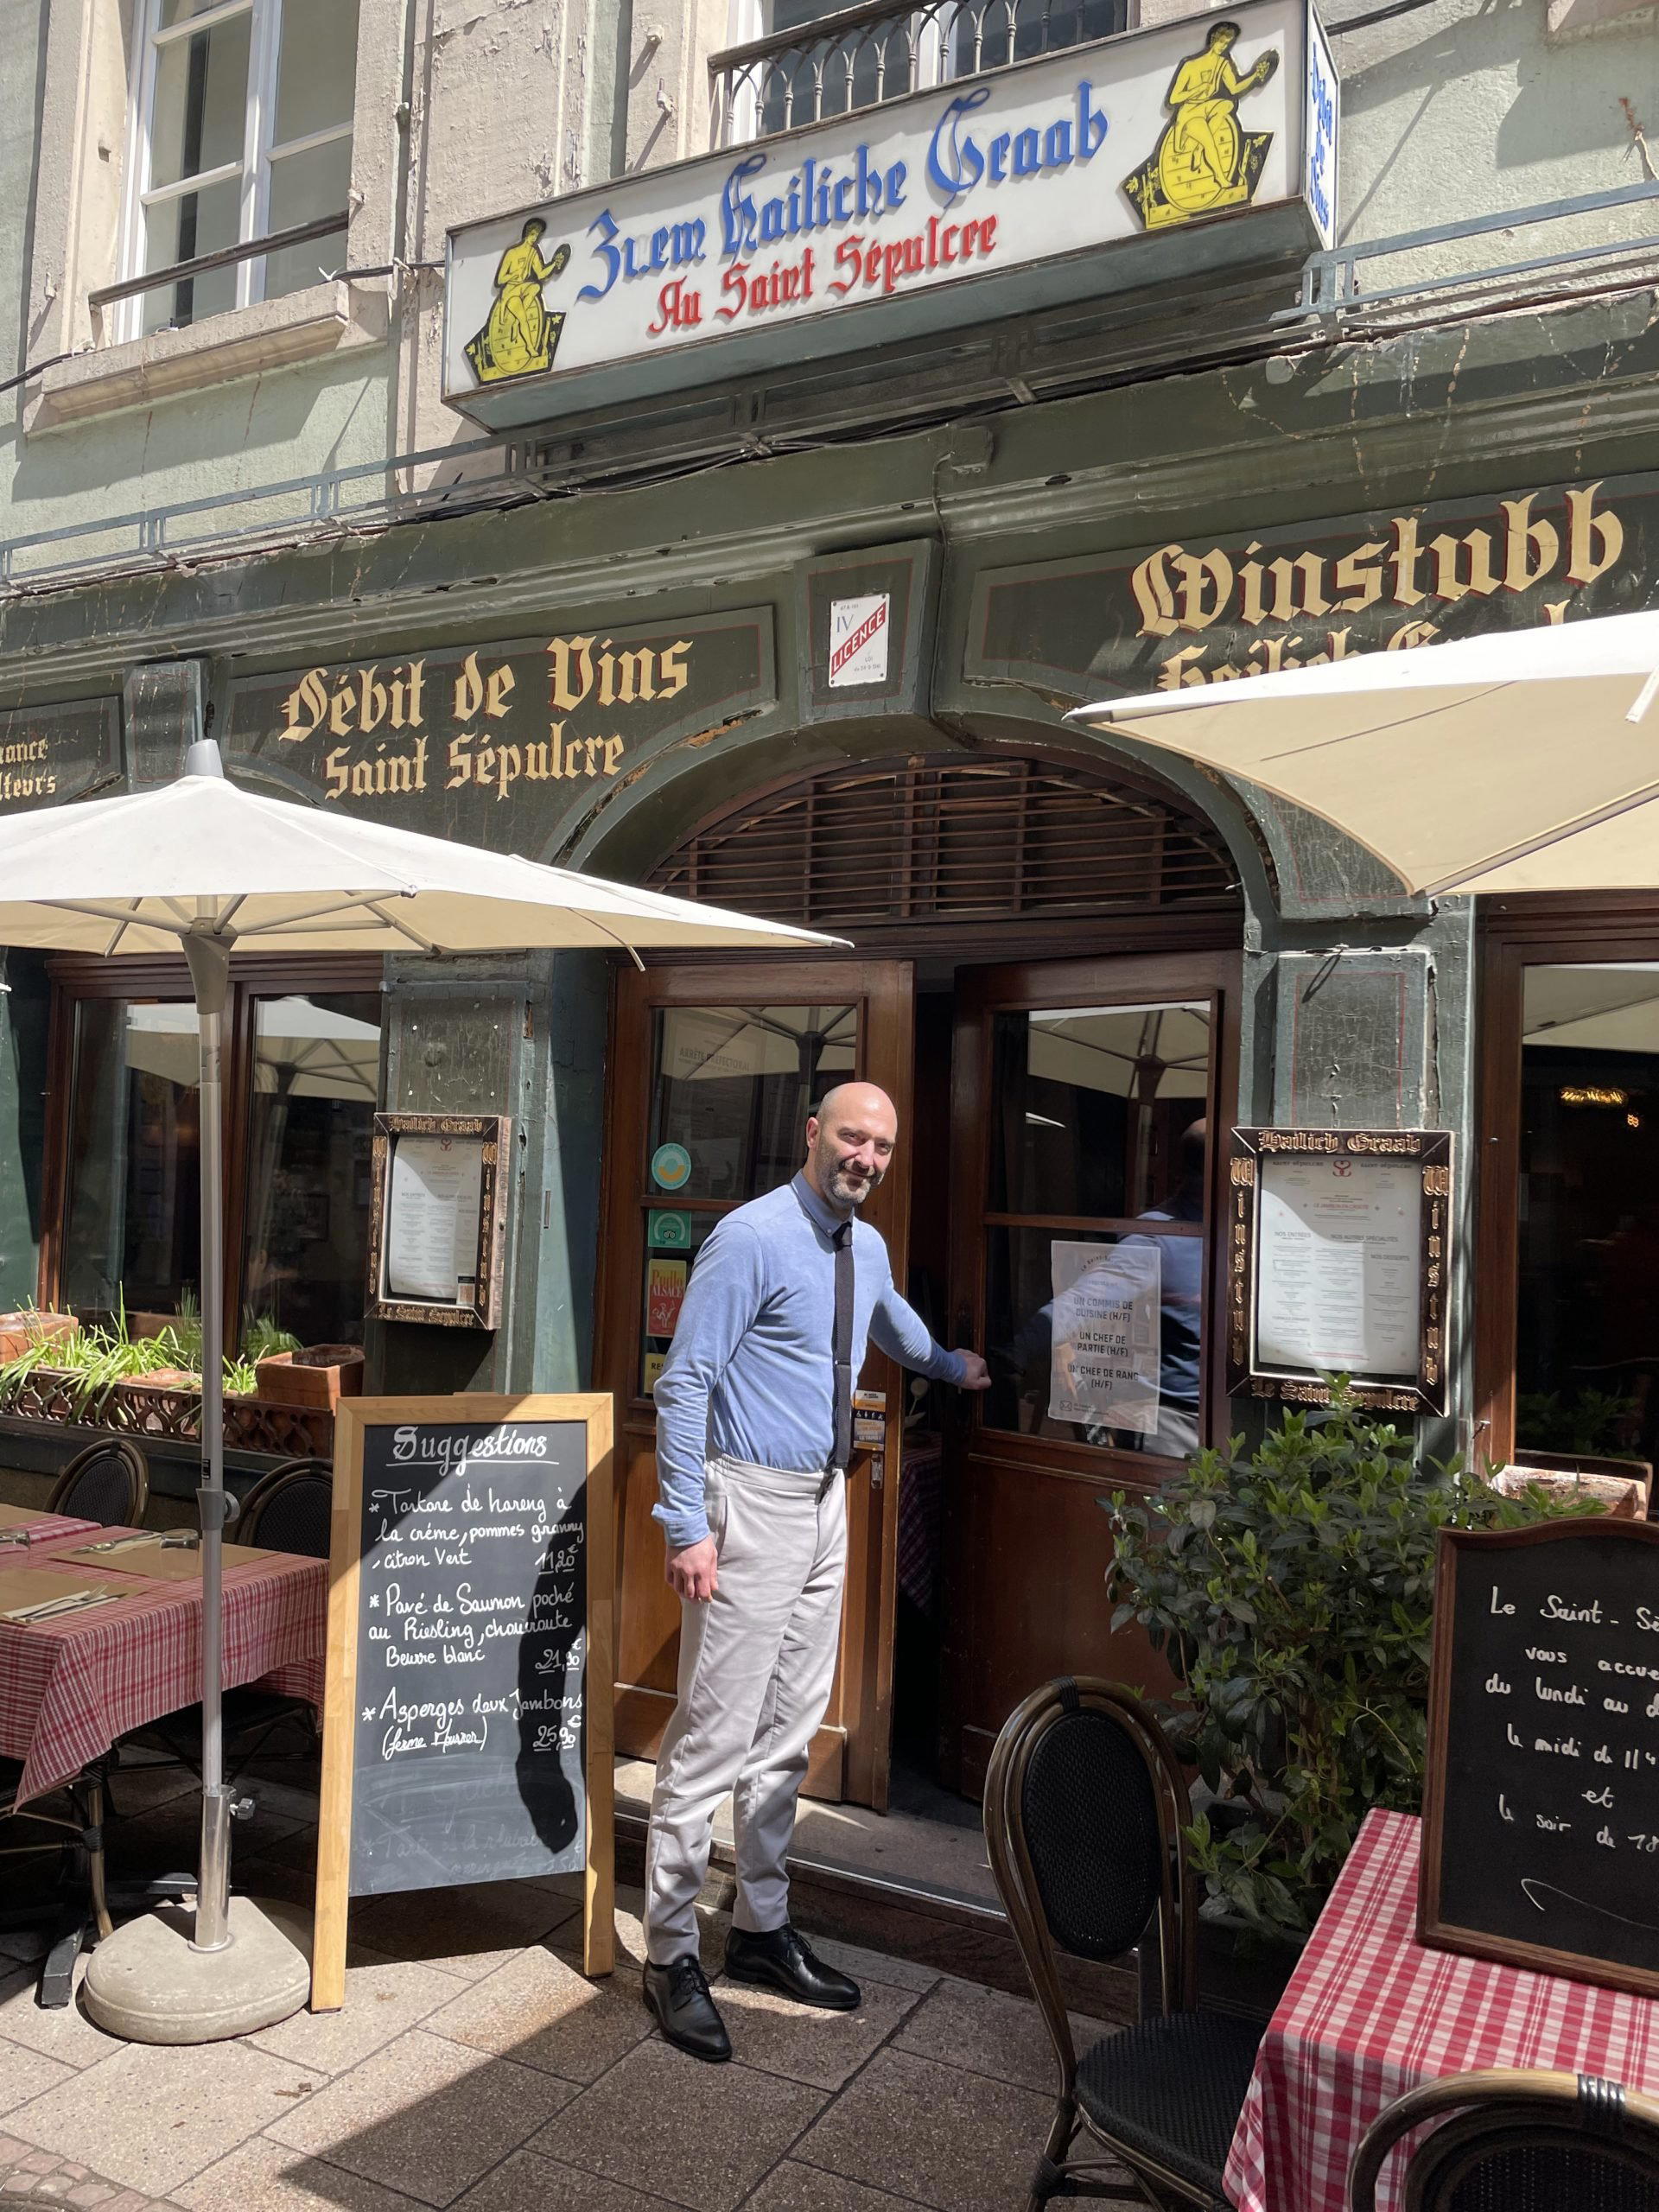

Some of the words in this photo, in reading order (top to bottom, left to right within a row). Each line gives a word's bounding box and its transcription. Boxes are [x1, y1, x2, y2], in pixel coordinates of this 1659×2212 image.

[648, 275, 702, 334] Au
[715, 247, 816, 319] Saint
[829, 214, 998, 294] Sépulcre
[1131, 480, 1624, 638] Winstubb
[837, 614, 854, 632] IV
[833, 607, 886, 672] LICENCE
[279, 658, 425, 742] Débit
[453, 651, 515, 723] de
[547, 636, 693, 712] Vins
[325, 735, 429, 802] Saint
[445, 722, 626, 802] Sépulcre
[1347, 1133, 1421, 1152] Graab
[1109, 1313, 1130, 1323] (H/F)
[1122, 1301, 1133, 1310] DE
[1077, 1344, 1104, 1354] PARTIE
[1107, 1345, 1128, 1357] (H/F)
[1080, 1332, 1090, 1340] UN
[1093, 1332, 1113, 1343] CHEF
[1115, 1335, 1126, 1344] DE
[1080, 1366, 1102, 1376] CHEF
[1103, 1368, 1114, 1378] DE
[1091, 1378, 1112, 1390] (H/F)
[393, 1425, 546, 1476] Suggestions
[372, 1488, 453, 1514] Tartare
[461, 1484, 482, 1512] de
[489, 1487, 546, 1522] hareng
[556, 1487, 571, 1510] à
[375, 1518, 404, 1541] la
[469, 1526, 525, 1544] pommes
[531, 1521, 584, 1543] granny
[435, 1548, 473, 1566] Vert
[385, 1583, 428, 1616] Pavé
[433, 1593, 454, 1612] de
[456, 1582, 525, 1614] Saumon
[532, 1582, 575, 1618] poché
[1491, 1586, 1516, 1615] Le
[1540, 1594, 1603, 1624] Saint
[368, 1624, 391, 1640] au
[386, 1645, 436, 1667] Beurre
[443, 1645, 486, 1662] blanc
[1525, 1646, 1568, 1664] vous
[1485, 1673, 1511, 1695] du
[1535, 1676, 1588, 1707] lundi
[1603, 1696, 1629, 1714] au
[379, 1686, 464, 1732] Asperges
[473, 1693, 508, 1714] deux
[508, 1688, 583, 1720] Jambons
[1507, 1722, 1523, 1749] le
[1535, 1736, 1580, 1758] midi
[1594, 1745, 1613, 1764] de
[1581, 1786, 1614, 1808] et
[1499, 1793, 1515, 1821] le
[1536, 1813, 1571, 1833] soir
[1596, 1826, 1616, 1848] de
